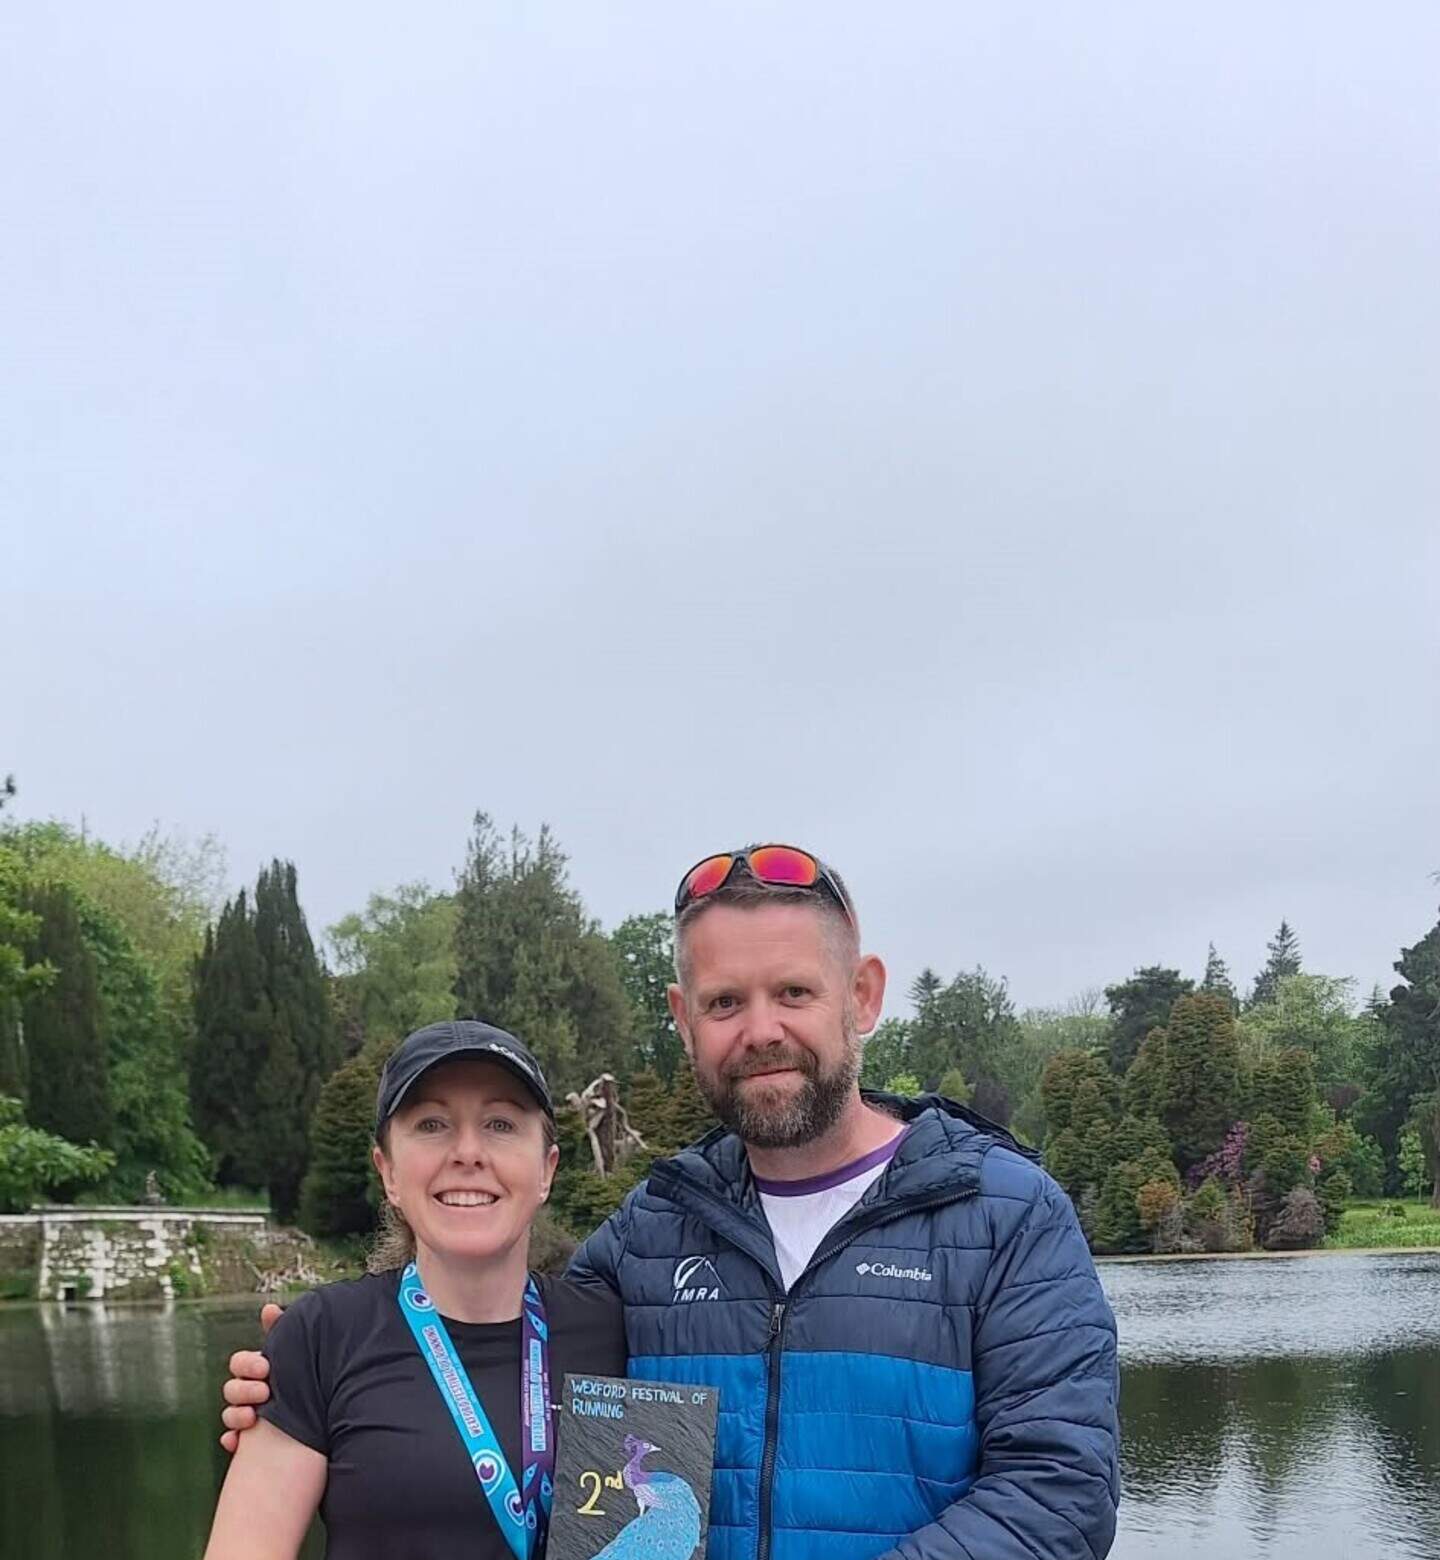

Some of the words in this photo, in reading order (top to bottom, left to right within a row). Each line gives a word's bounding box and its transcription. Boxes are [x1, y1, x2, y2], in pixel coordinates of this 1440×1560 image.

[870, 1262, 932, 1281] Columbia
[673, 1287, 719, 1303] IMRA
[571, 1380, 626, 1399] WEXFORD
[632, 1387, 684, 1404] FESTIVAL
[692, 1392, 707, 1405] OF
[572, 1398, 624, 1419] RUNNING
[577, 1470, 623, 1516] 2nd
